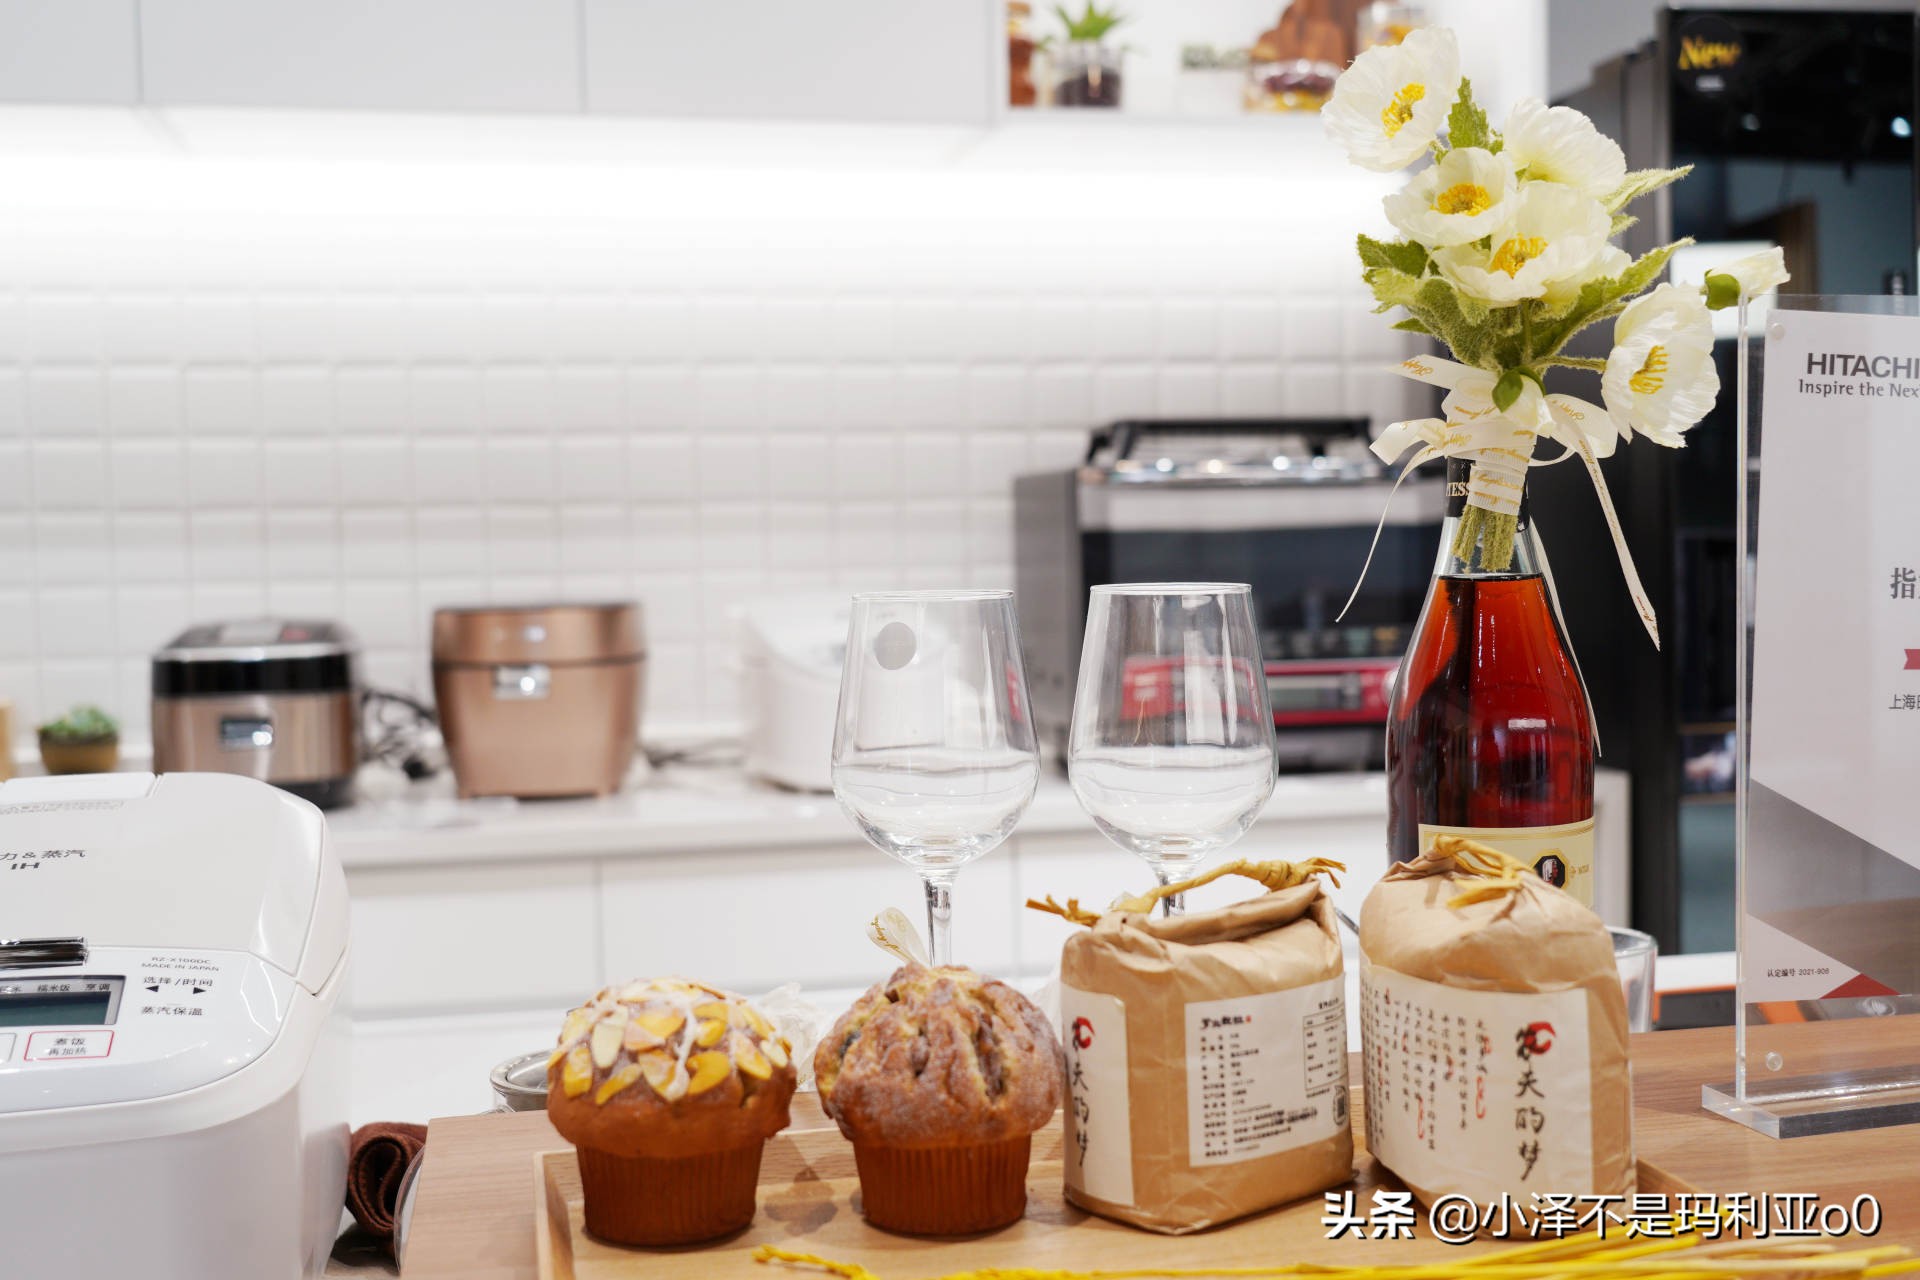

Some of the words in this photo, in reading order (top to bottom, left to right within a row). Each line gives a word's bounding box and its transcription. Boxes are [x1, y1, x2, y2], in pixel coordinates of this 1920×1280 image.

[1807, 352, 1920, 379] HITACHI
[1799, 379, 1854, 397] Inspire
[1860, 381, 1884, 397] the
[1889, 383, 1920, 398] Nex
[1767, 968, 1796, 978] 认定编号
